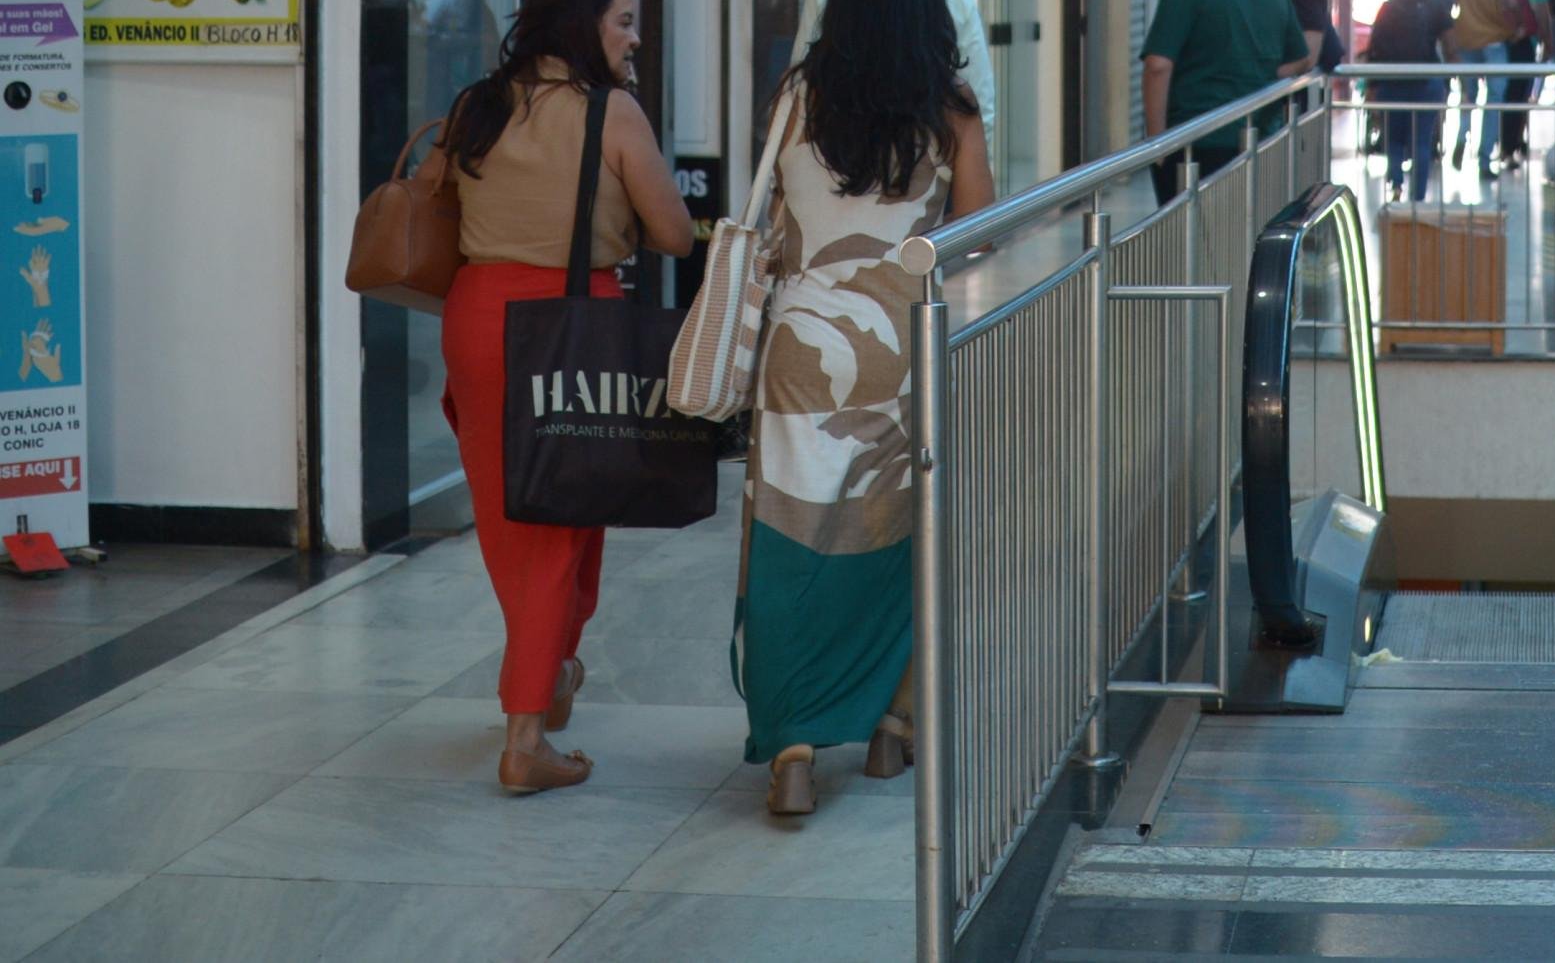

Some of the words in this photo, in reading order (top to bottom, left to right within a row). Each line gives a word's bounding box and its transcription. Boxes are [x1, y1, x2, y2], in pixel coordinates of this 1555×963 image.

[7, 9, 30, 18] suas
[33, 8, 64, 18] mãos!
[10, 24, 29, 33] em
[32, 22, 53, 33] Gel
[89, 25, 112, 42] ED.
[116, 20, 186, 42] VENÂNCIO
[22, 62, 72, 72] CONSERTOS
[0, 405, 65, 422] VENÂNCIO
[14, 424, 28, 437] H,
[30, 420, 63, 434] LOJA
[67, 419, 80, 431] 18
[536, 422, 604, 439] TRANSPLANTE
[608, 425, 615, 438] E
[3, 436, 45, 452] CONIC
[26, 461, 60, 478] AQUI
